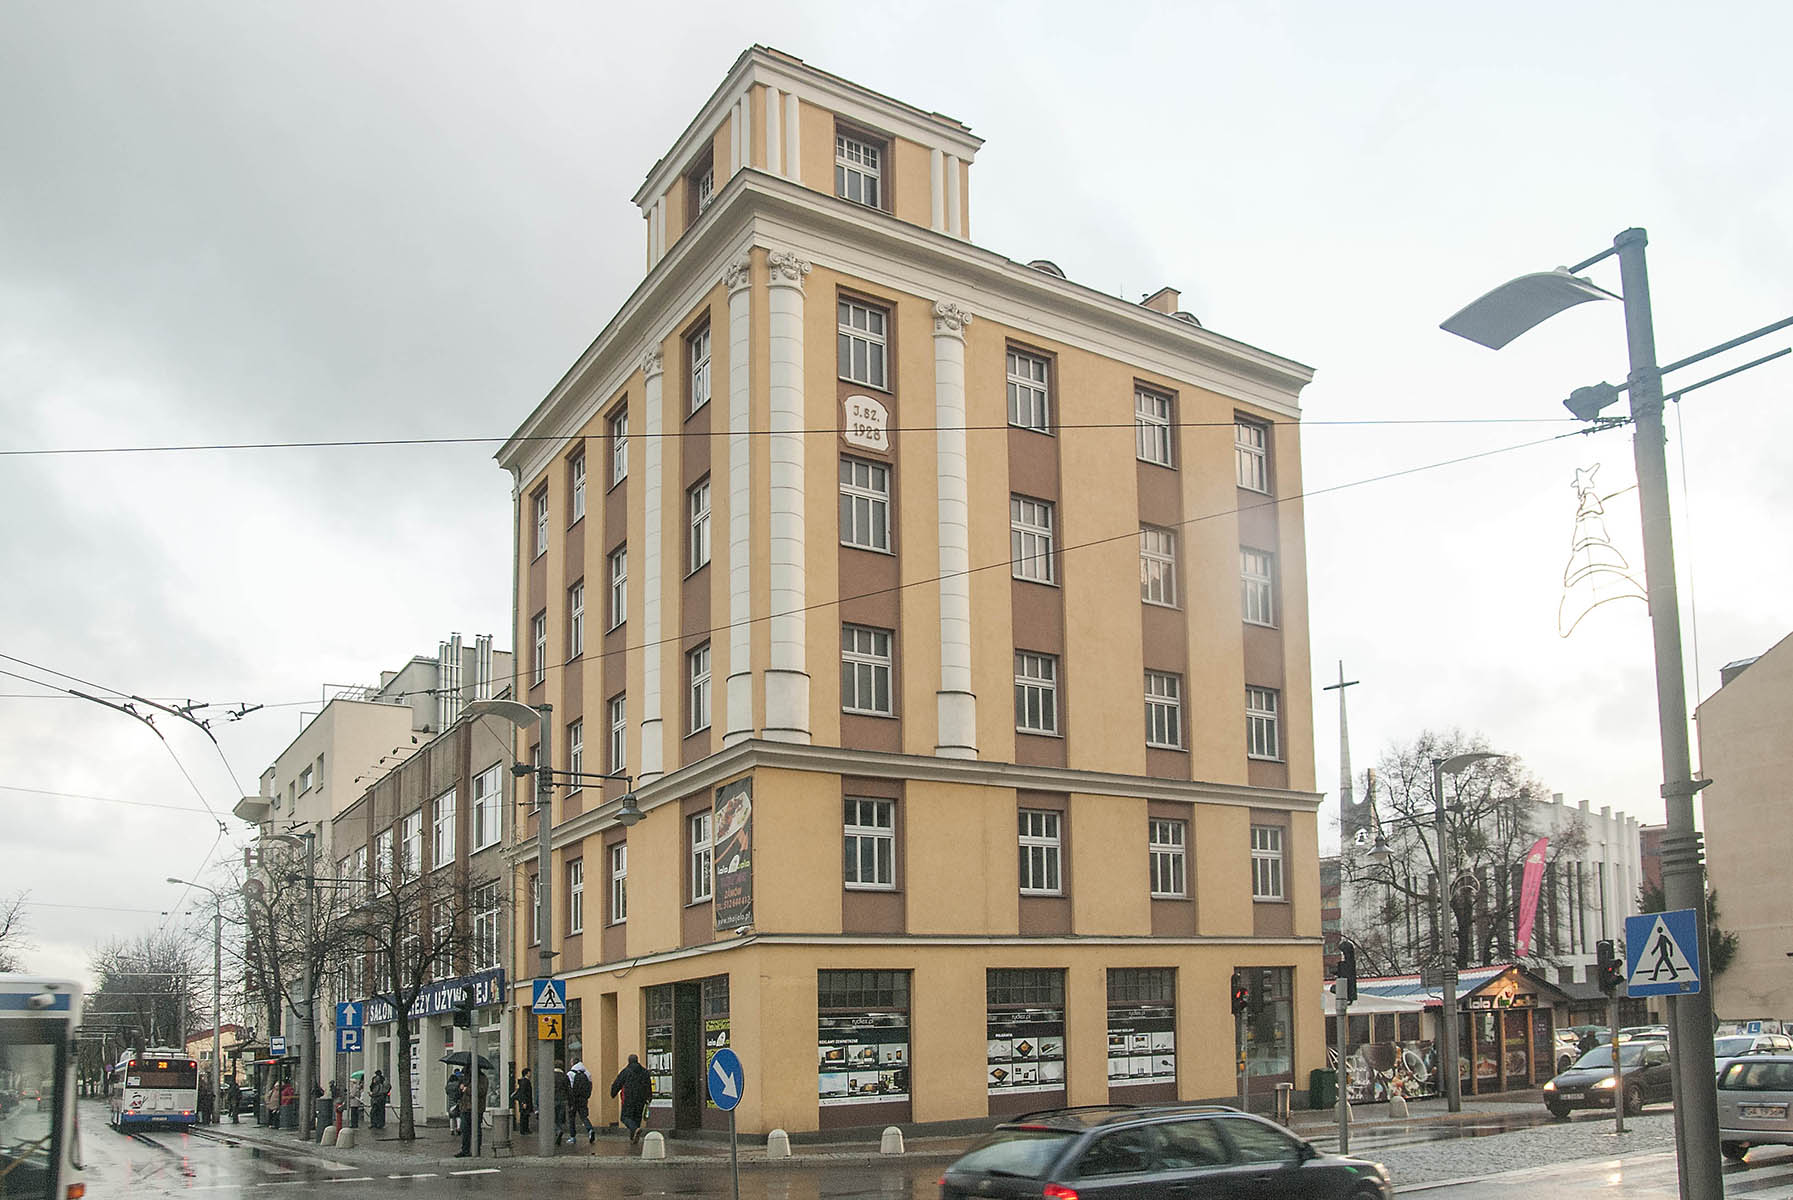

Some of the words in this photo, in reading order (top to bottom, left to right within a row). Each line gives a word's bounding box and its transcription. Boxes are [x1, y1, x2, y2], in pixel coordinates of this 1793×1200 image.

[369, 1002, 393, 1021] SALON
[1751, 1024, 1758, 1032] L
[342, 1030, 357, 1050] P
